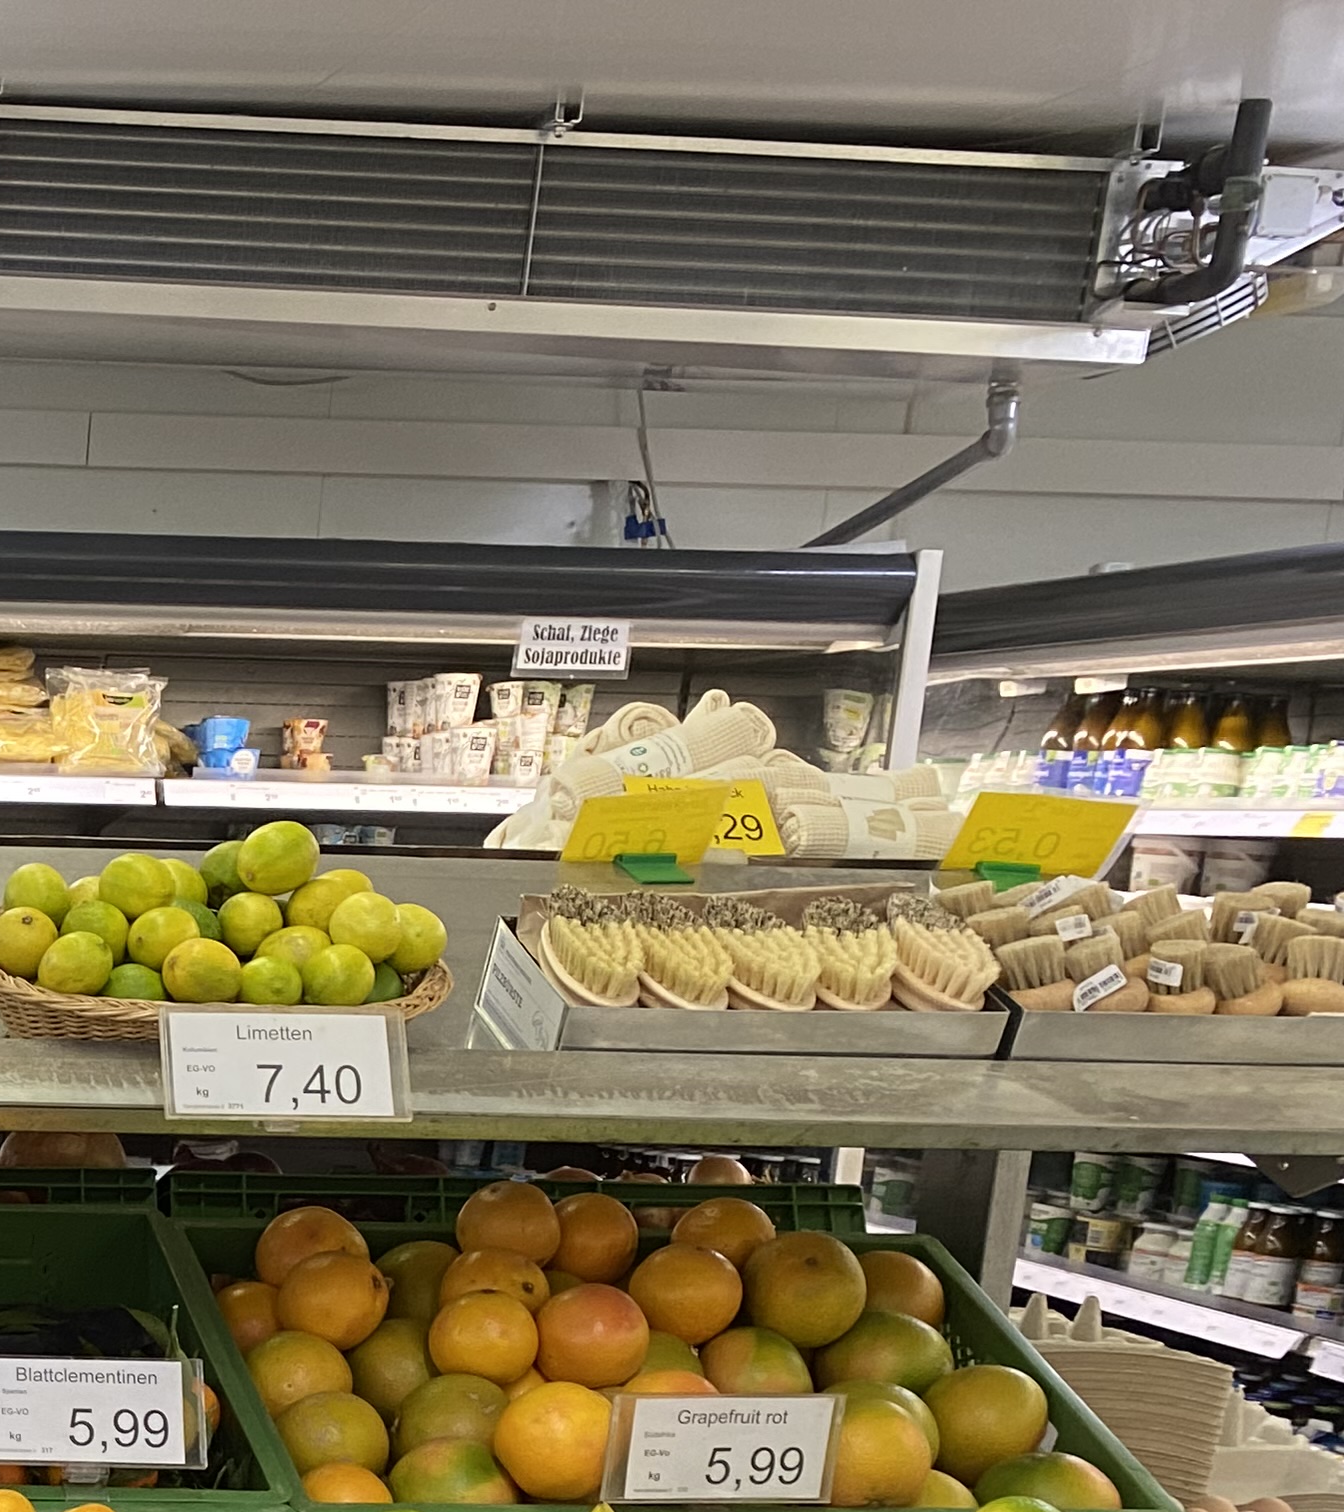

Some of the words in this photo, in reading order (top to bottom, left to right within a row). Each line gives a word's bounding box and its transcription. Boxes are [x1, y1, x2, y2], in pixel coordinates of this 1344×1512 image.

[532, 624, 574, 642] Schaf,
[580, 625, 618, 644] Ziege
[524, 648, 621, 666] Sojaprodukte
[713, 813, 763, 844] ,29
[236, 1025, 313, 1041] Limetten
[187, 1065, 216, 1073] EG-VO
[196, 1087, 210, 1097] kg
[256, 1064, 362, 1110] 7,40
[15, 1367, 158, 1385] Blattclementinen
[1, 1407, 29, 1416] EG-VO
[677, 1409, 761, 1428] Grapefruit
[765, 1409, 788, 1424] rot
[9, 1432, 22, 1443] kg
[69, 1408, 170, 1453] 5,99
[648, 1471, 660, 1481] kg
[705, 1447, 805, 1491] 5,99
